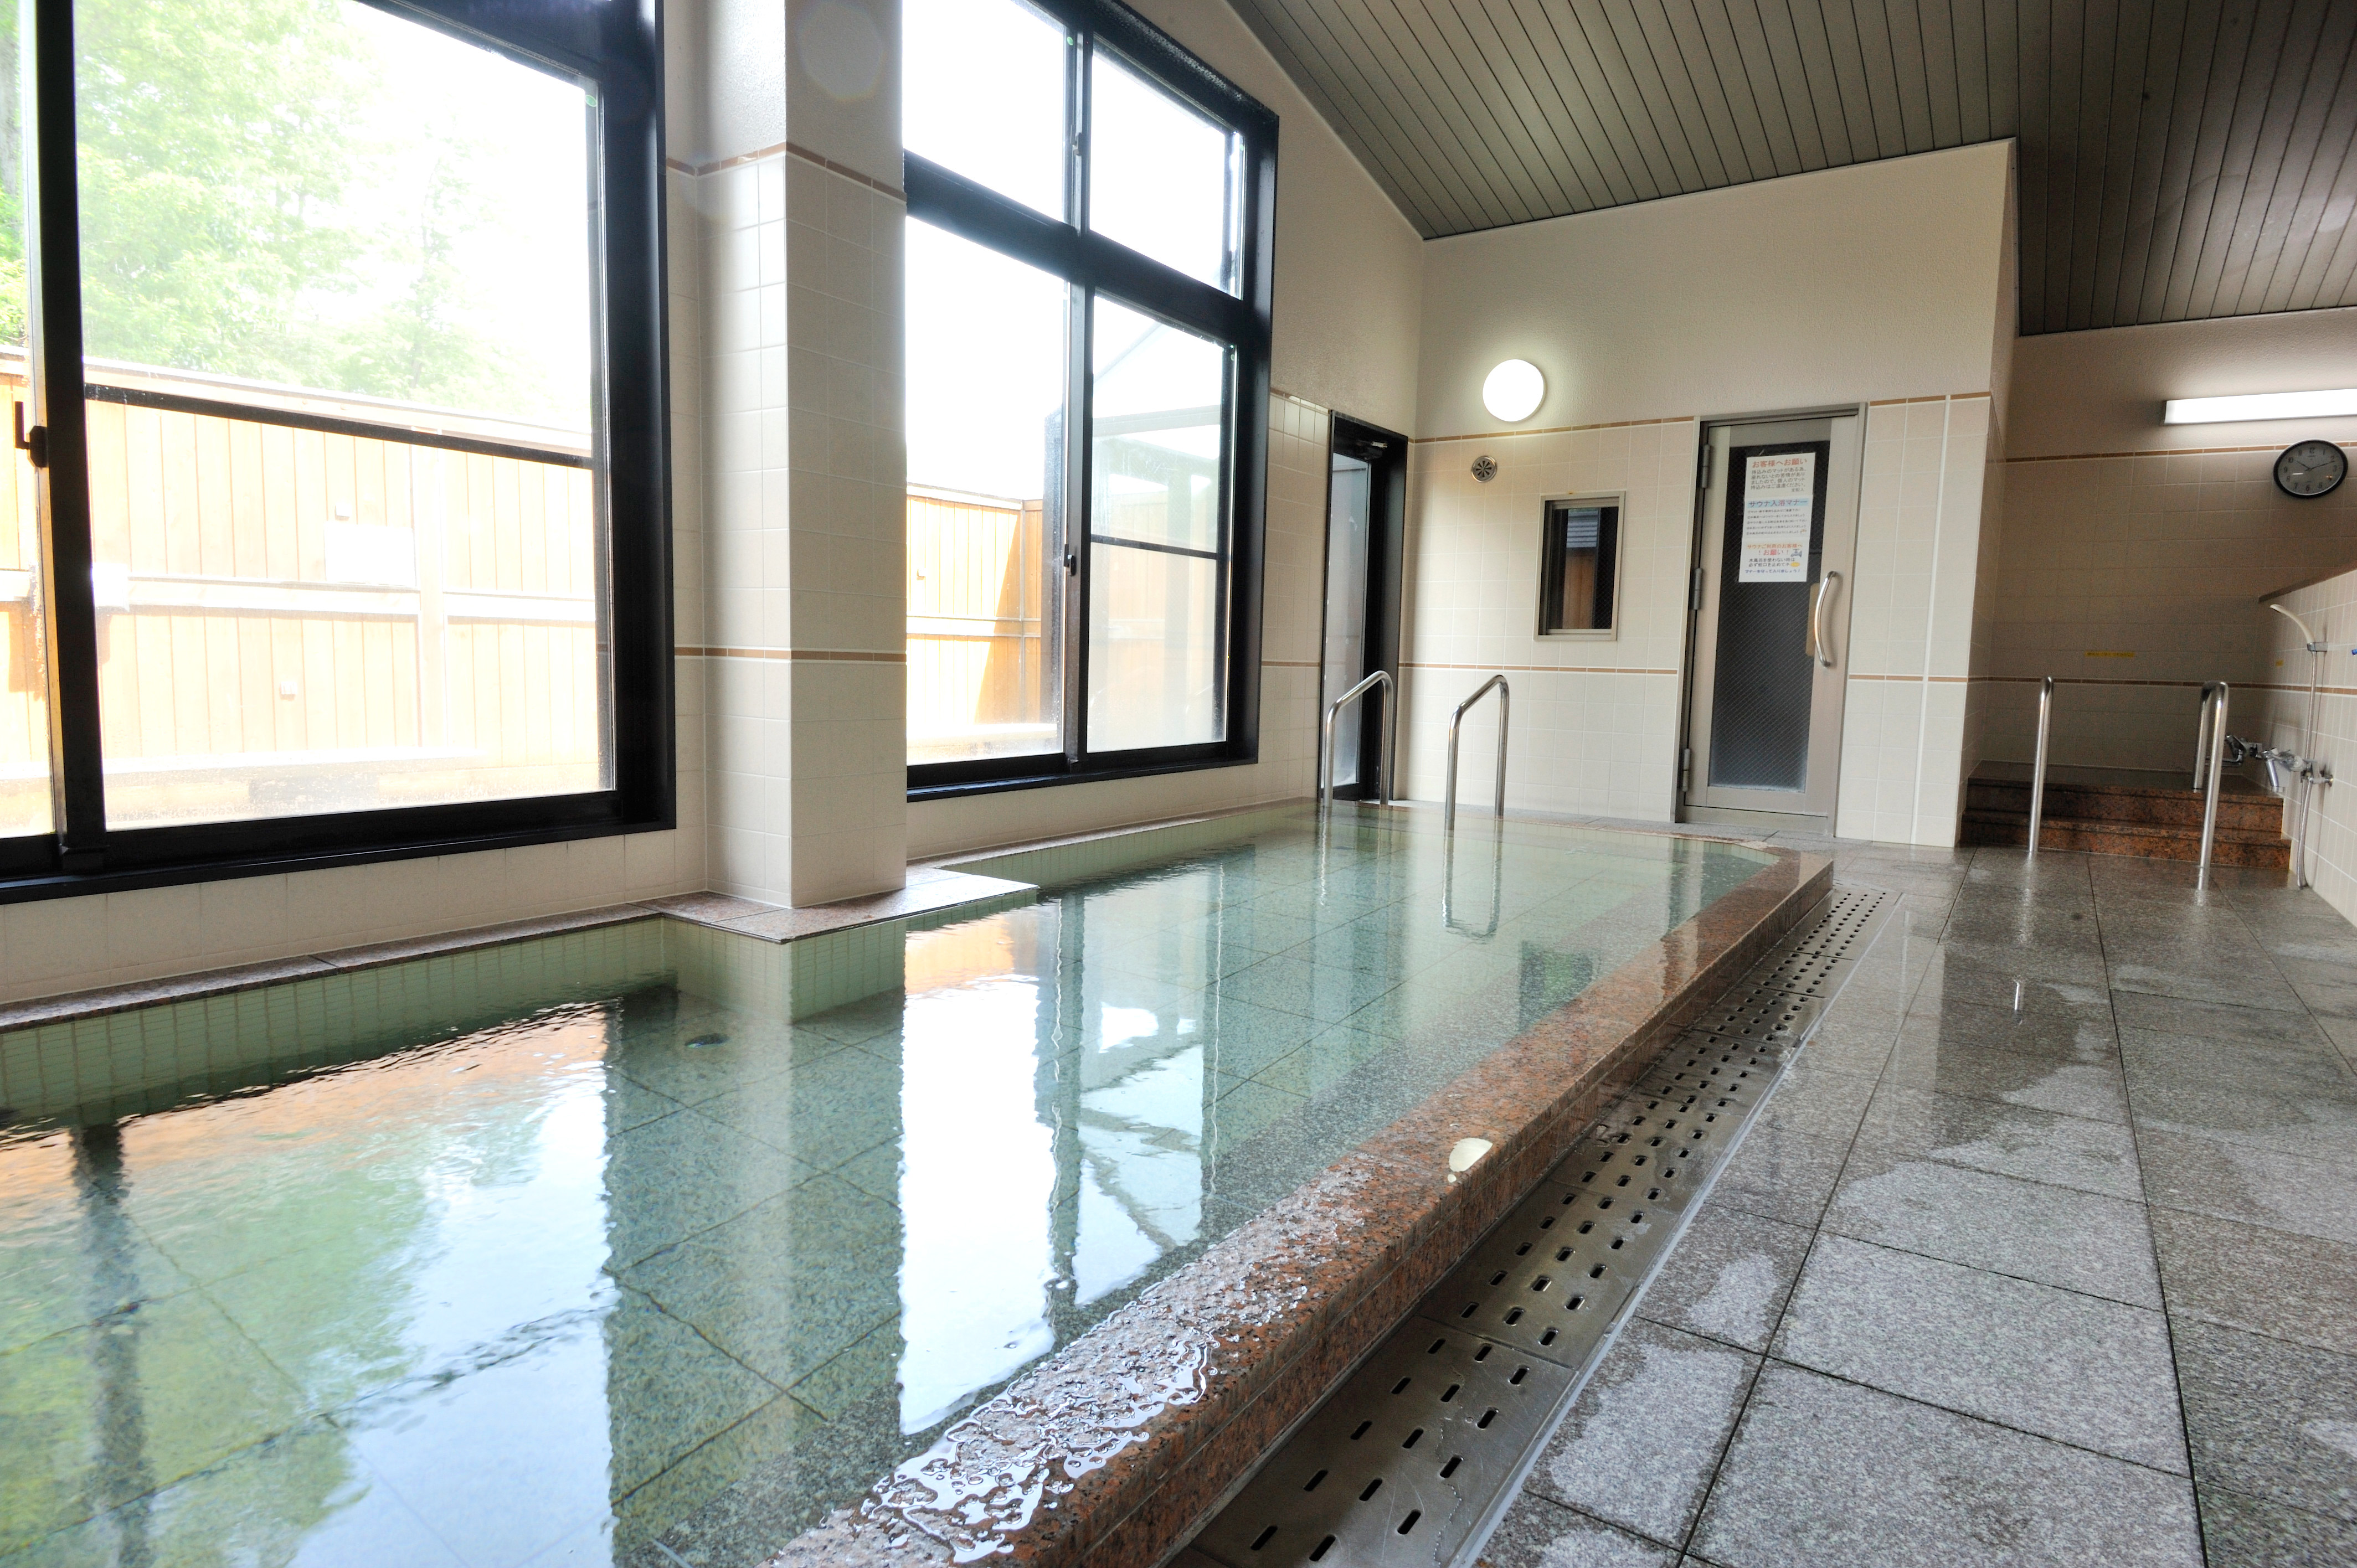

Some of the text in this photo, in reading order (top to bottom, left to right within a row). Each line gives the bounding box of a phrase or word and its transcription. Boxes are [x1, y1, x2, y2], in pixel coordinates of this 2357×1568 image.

[1748, 499, 1808, 508] サウナ入浴マナー
